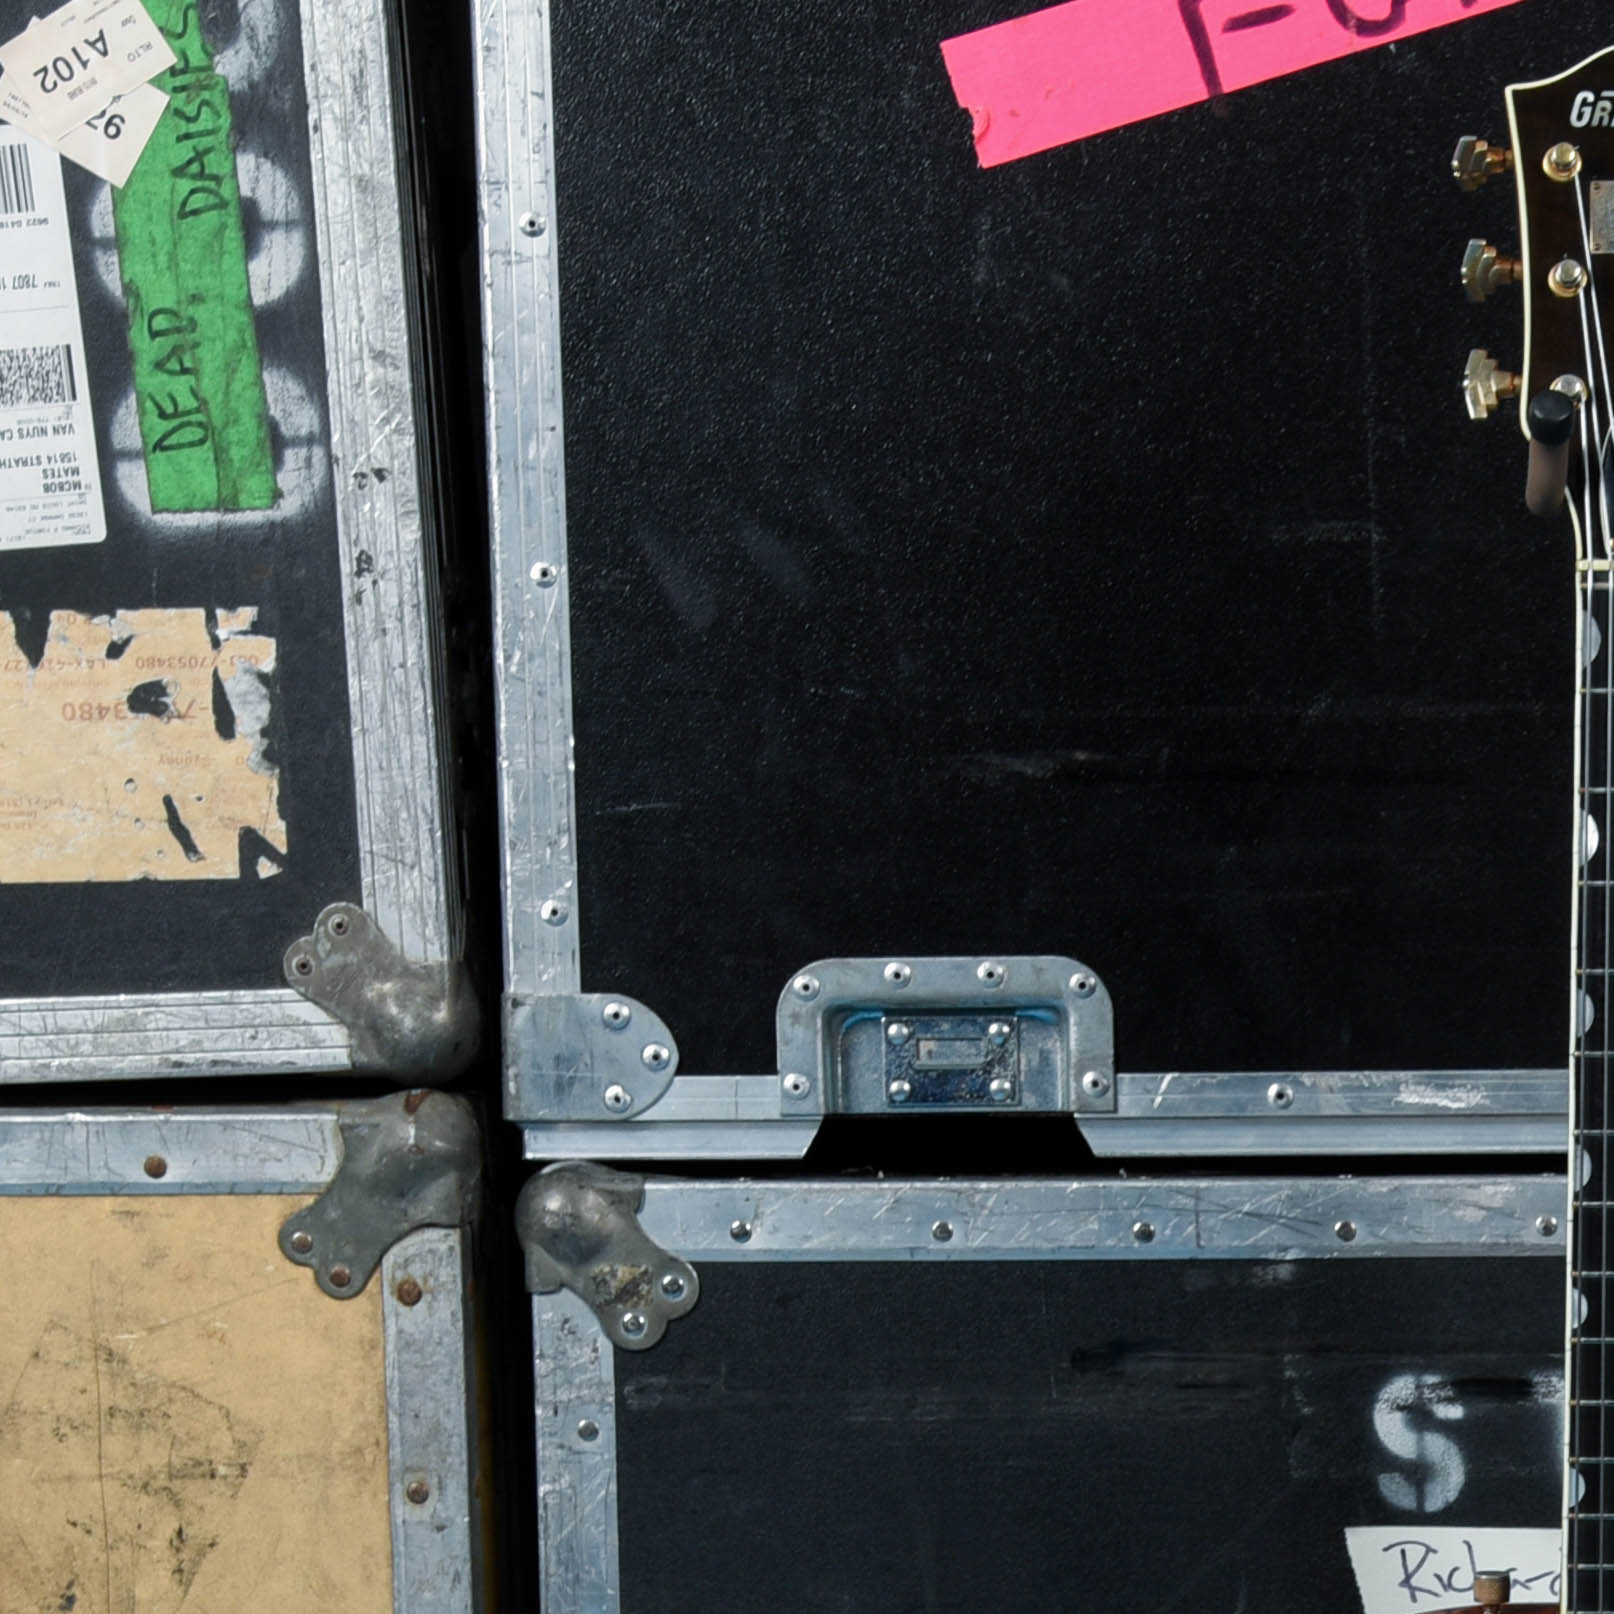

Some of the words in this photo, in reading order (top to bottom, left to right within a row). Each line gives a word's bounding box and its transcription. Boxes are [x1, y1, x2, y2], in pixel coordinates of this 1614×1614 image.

[33, 29, 109, 93] A102
[17, 426, 48, 440] NUYS
[52, 423, 75, 436] VAN
[42, 467, 80, 479] MATES
[43, 480, 82, 493] MCBOB
